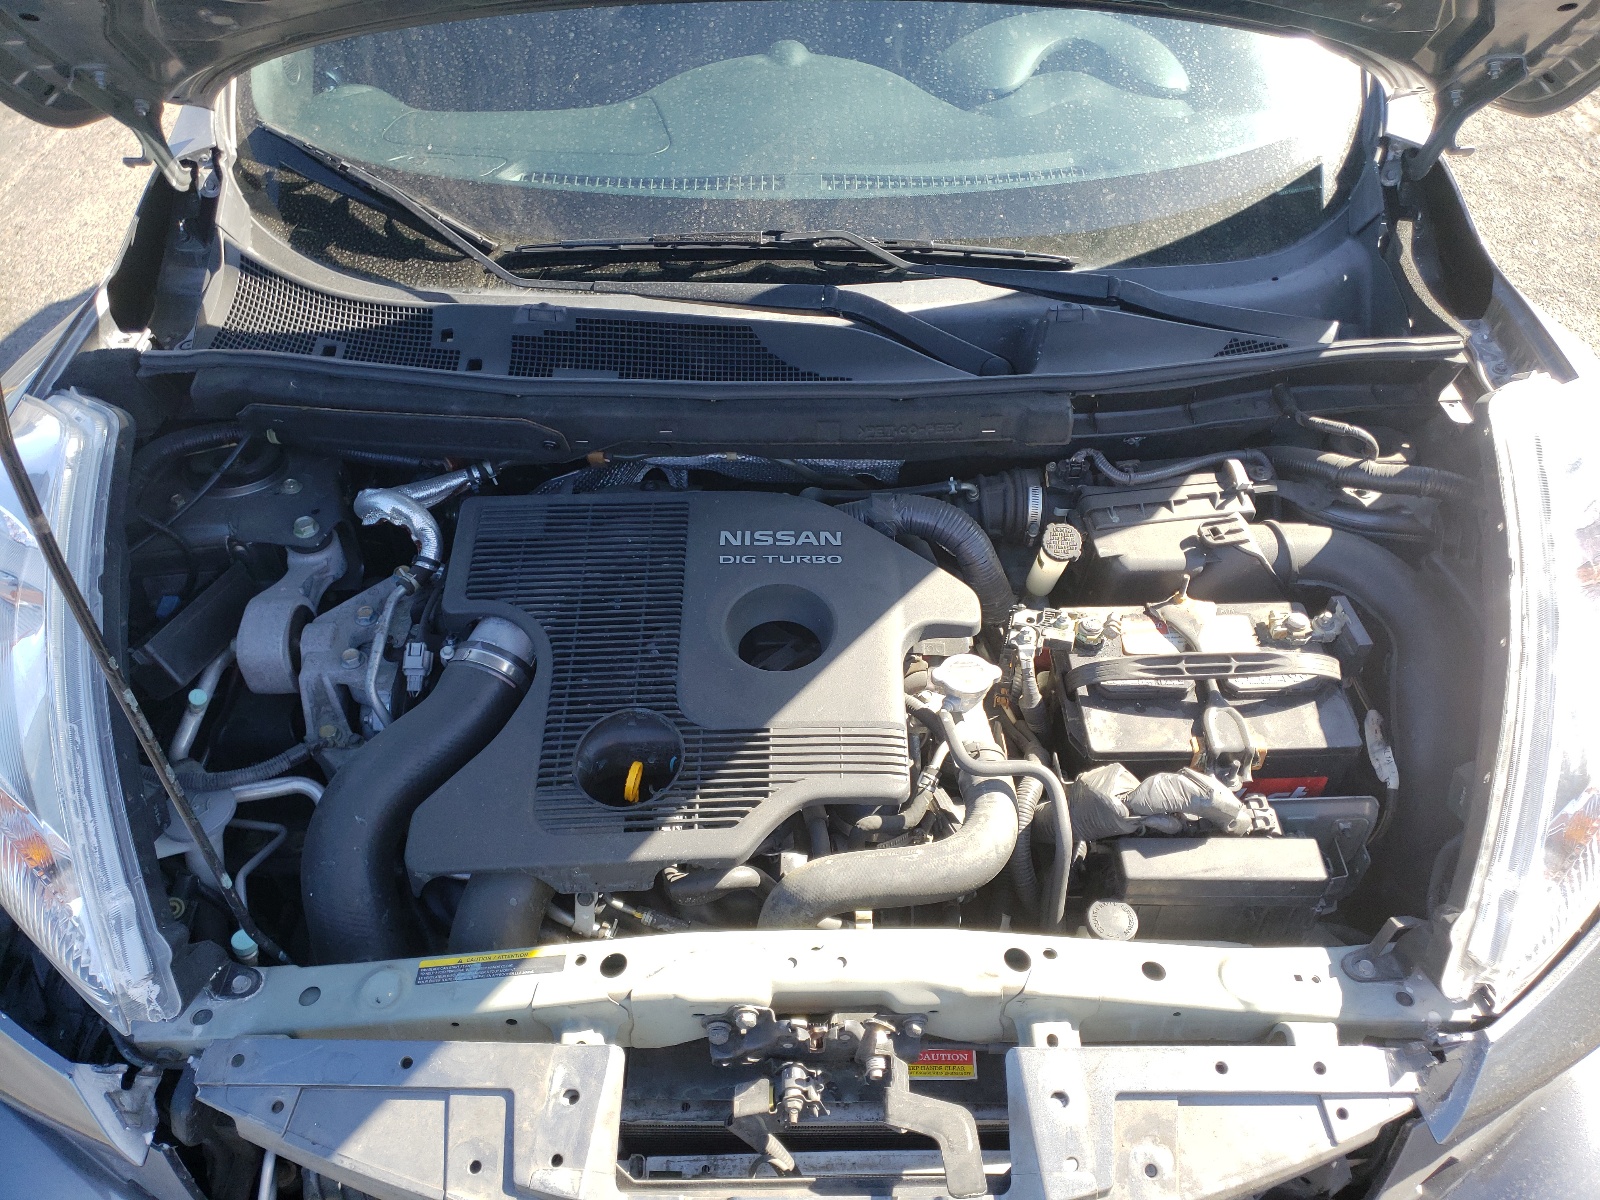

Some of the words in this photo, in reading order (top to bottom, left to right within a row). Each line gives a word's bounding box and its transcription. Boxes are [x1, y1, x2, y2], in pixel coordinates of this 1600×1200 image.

[719, 530, 842, 546] NISSAN
[719, 555, 756, 564] DIG
[762, 555, 843, 564] TURBO
[497, 952, 529, 960] ATTENTION
